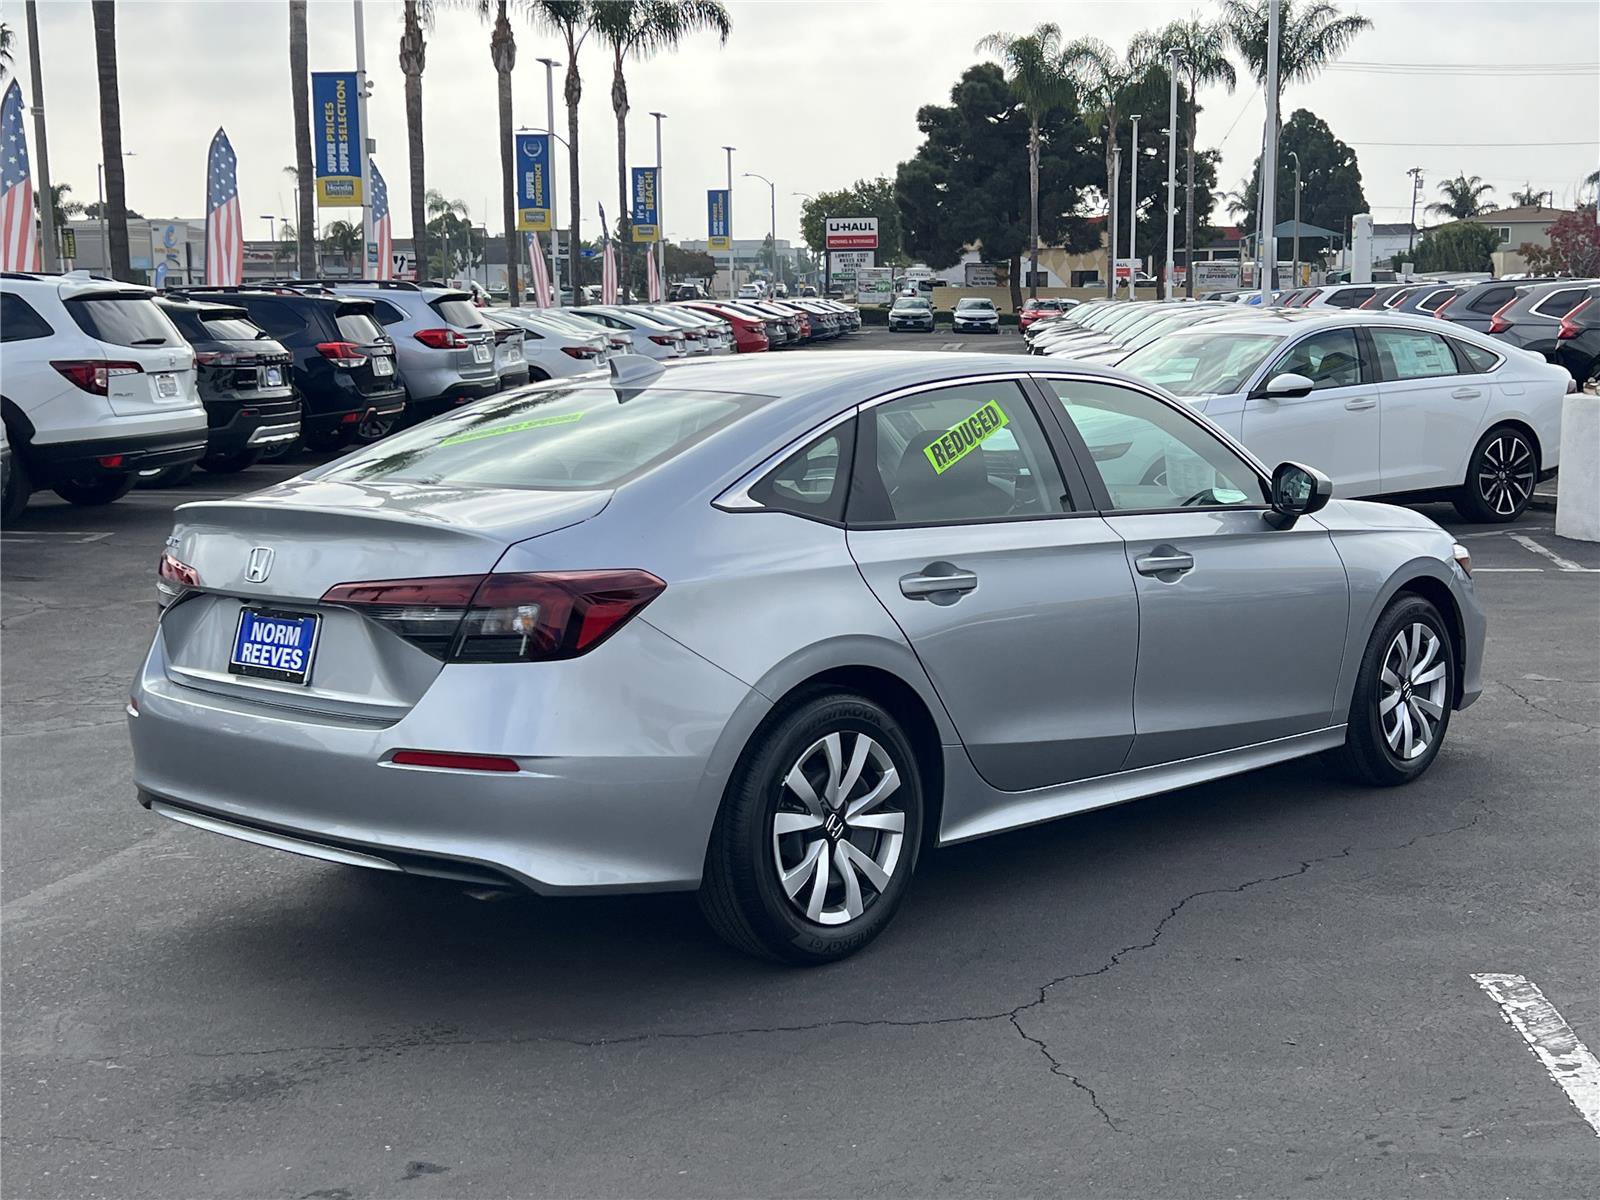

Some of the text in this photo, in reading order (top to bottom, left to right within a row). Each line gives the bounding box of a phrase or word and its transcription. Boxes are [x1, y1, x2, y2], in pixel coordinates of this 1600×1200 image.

[336, 80, 348, 141] SELECTION
[325, 102, 337, 173] SUPER PRICES
[339, 142, 349, 173] SUPER
[326, 183, 353, 192] Honda
[525, 171, 535, 200] SUPER
[534, 163, 543, 206] EXPERIENCE
[636, 174, 645, 203] Better
[644, 171, 654, 210] BEACH!
[830, 223, 875, 231] U-HAUL
[930, 405, 1002, 468] REDUCED
[250, 621, 302, 647] NORM
[241, 642, 304, 670] REEVES
